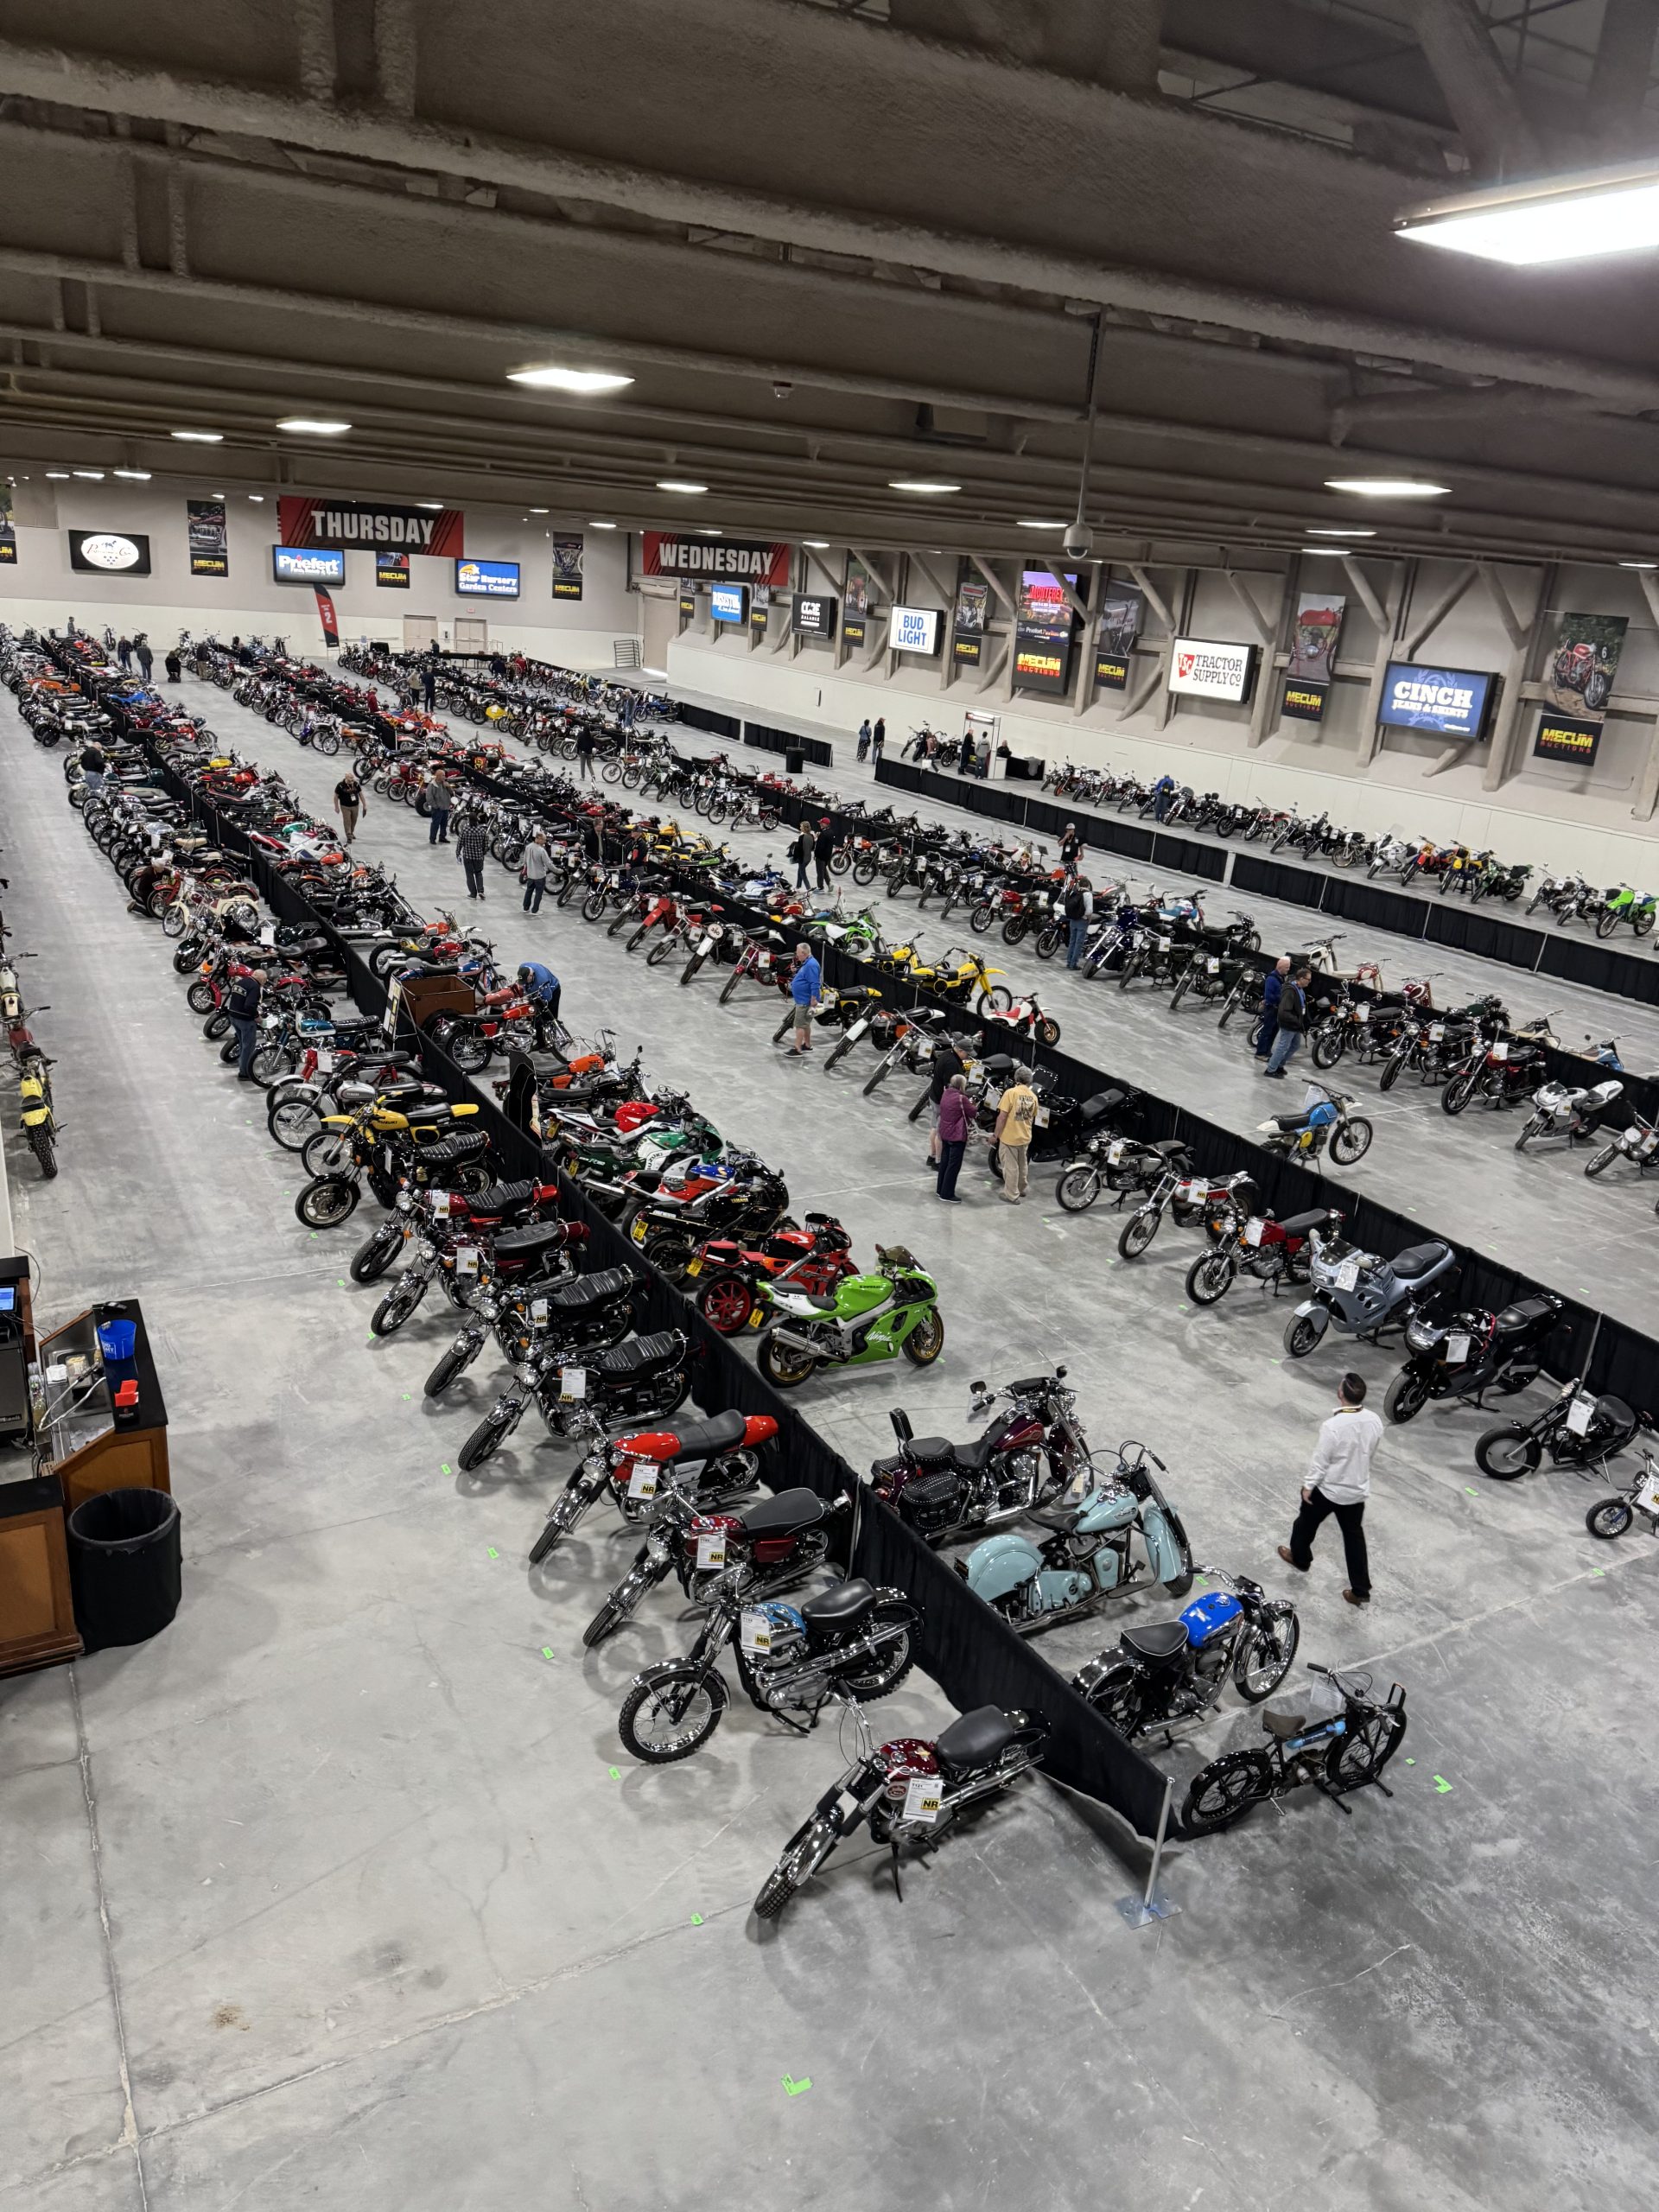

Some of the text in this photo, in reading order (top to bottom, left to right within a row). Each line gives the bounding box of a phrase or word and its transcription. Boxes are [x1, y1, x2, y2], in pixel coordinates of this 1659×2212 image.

[310, 510, 435, 545] THURSDAY
[193, 559, 225, 569] MECUM
[278, 555, 340, 574] Priefert
[659, 543, 774, 575] WEDNESDAY
[378, 571, 407, 581] MECUM
[480, 575, 518, 587] Nursery
[459, 582, 518, 593] Garden Centers
[555, 584, 580, 594] MECUM
[1029, 584, 1064, 604] MONTEREY
[324, 611, 333, 624] 2
[903, 614, 925, 631] BUD
[898, 628, 927, 646] LIGHT
[1601, 646, 1607, 659] 6
[1017, 653, 1062, 671] MECUM
[1178, 653, 1192, 674] TSC
[1196, 654, 1243, 672] TRACTOR
[1098, 663, 1125, 677] MECUM
[1192, 668, 1230, 685] SUPPLY
[1286, 690, 1323, 707] MECUM
[1394, 681, 1472, 709] CINCH
[1541, 728, 1595, 748] MECUM
[1539, 741, 1592, 754] AUCTIONS
[867, 1330, 892, 1342] Ninja
[642, 1484, 654, 1493] NR
[756, 1636, 769, 1644] NR
[923, 1799, 938, 1809] NR
